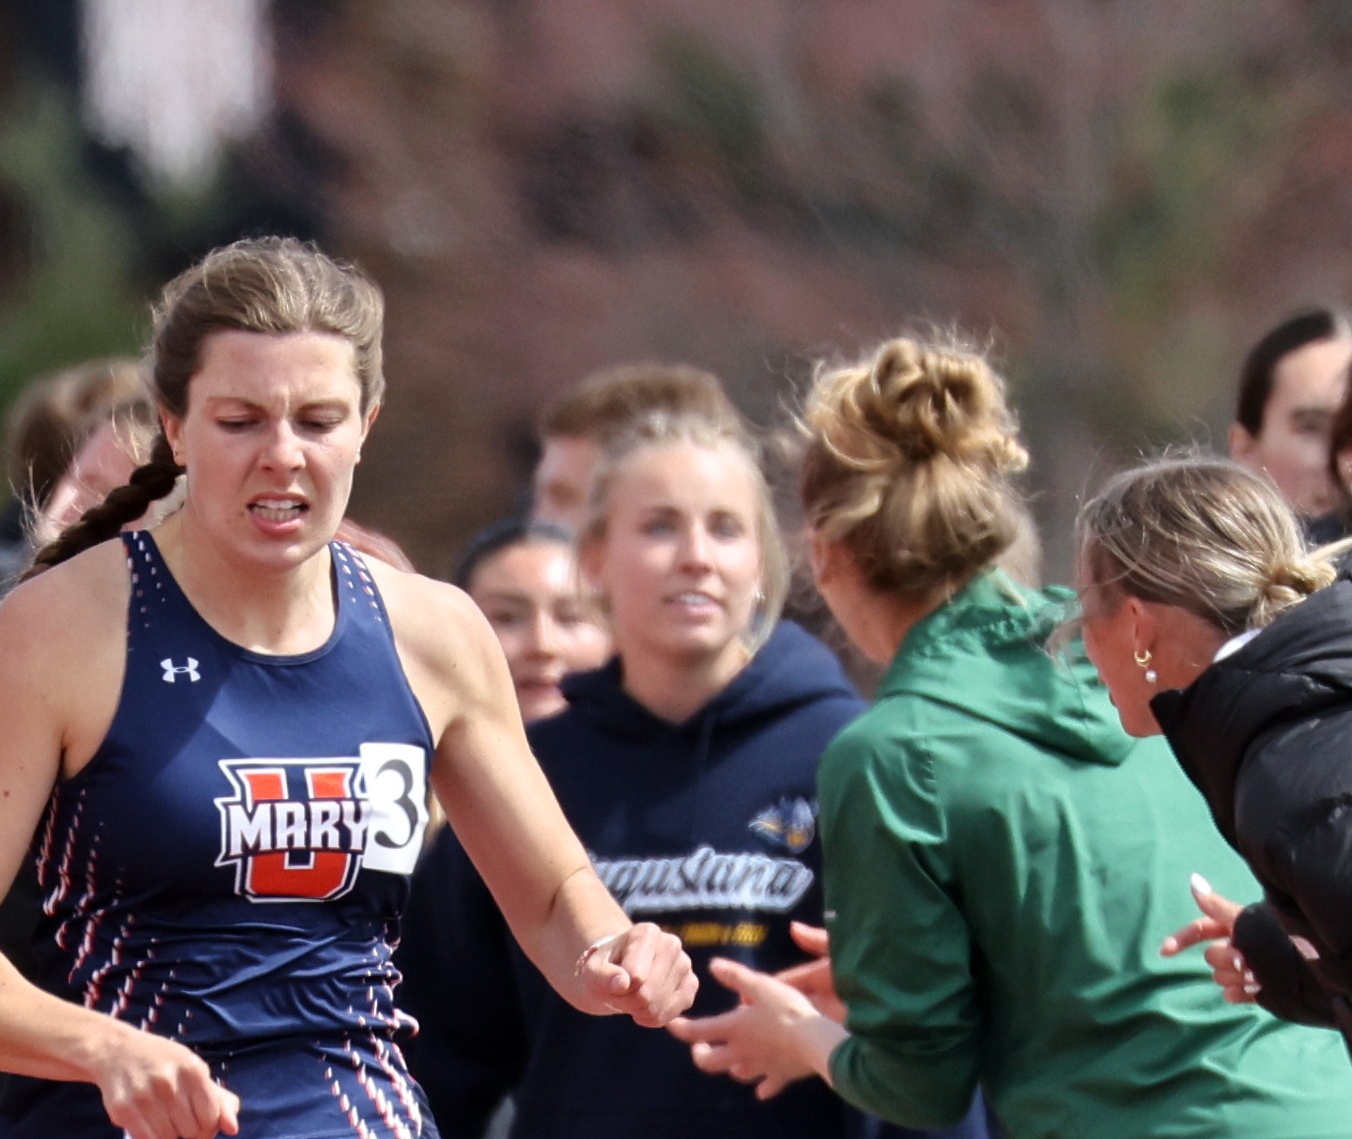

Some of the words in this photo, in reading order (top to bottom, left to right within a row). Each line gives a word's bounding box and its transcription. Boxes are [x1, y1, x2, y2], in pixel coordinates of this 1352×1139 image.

[227, 799, 369, 856] MARY
[374, 758, 419, 849] 3
[593, 845, 814, 911] gustana
